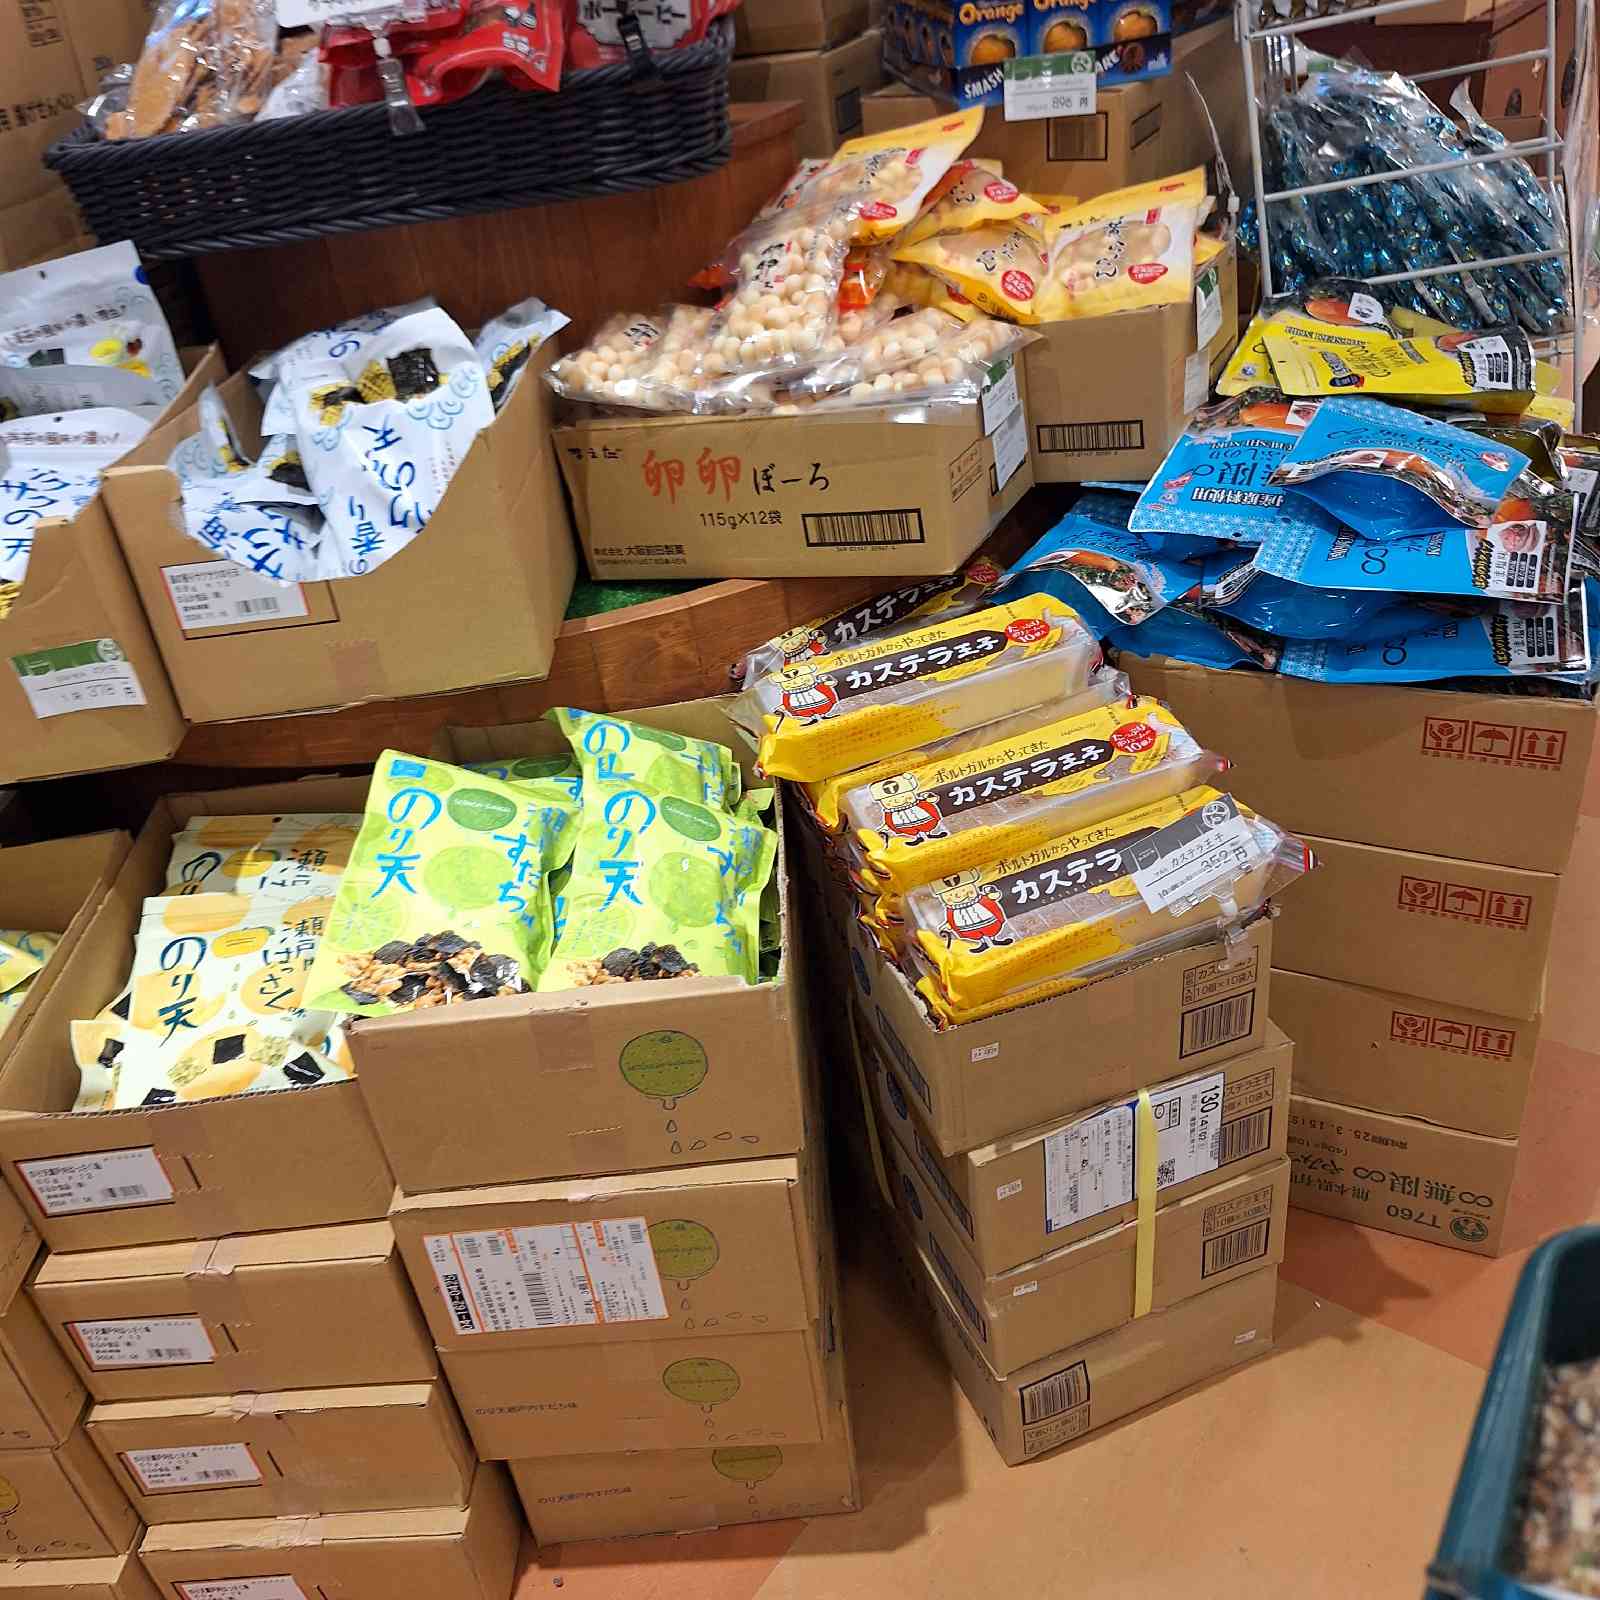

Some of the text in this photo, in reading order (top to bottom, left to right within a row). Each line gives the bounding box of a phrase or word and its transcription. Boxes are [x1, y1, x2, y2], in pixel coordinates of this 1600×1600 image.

[959, 3, 1024, 26] Orange
[964, 66, 1004, 99] SMASH
[832, 629, 947, 666] ポルトガルからやってきた
[846, 635, 1000, 690] カステラ王子
[934, 740, 1049, 784] ポルトガルからやってきた
[948, 746, 1105, 806] カステラ王子
[371, 787, 443, 898] のり天
[598, 790, 657, 913] のり天
[994, 826, 1116, 875] ポルトガルからやってきた
[158, 936, 208, 1048] のり天
[1200, 1085, 1221, 1113] 130
[1386, 1205, 1441, 1229] T760
